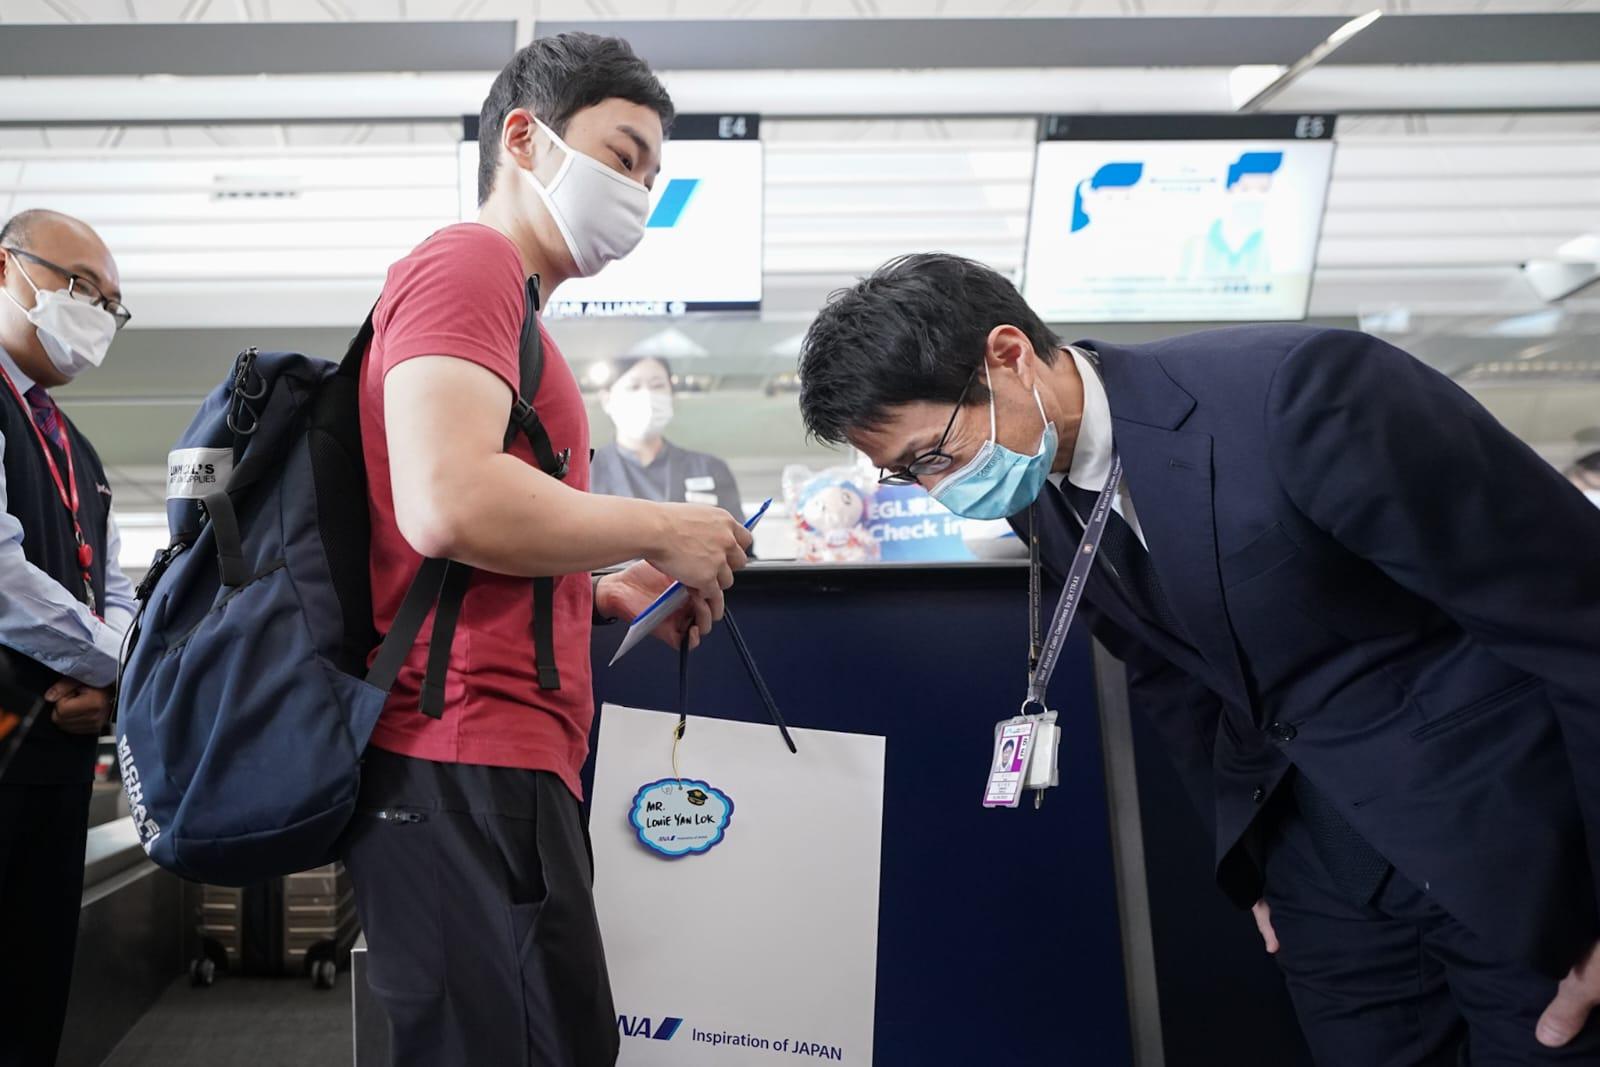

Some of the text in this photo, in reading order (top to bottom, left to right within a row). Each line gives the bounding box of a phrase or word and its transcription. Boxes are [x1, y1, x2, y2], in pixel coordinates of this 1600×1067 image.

[719, 116, 746, 138] E4
[869, 519, 939, 542] Check
[646, 801, 665, 813] MR.
[617, 1015, 651, 1039] NA
[692, 1028, 843, 1061] Inspiration of JAPAN
